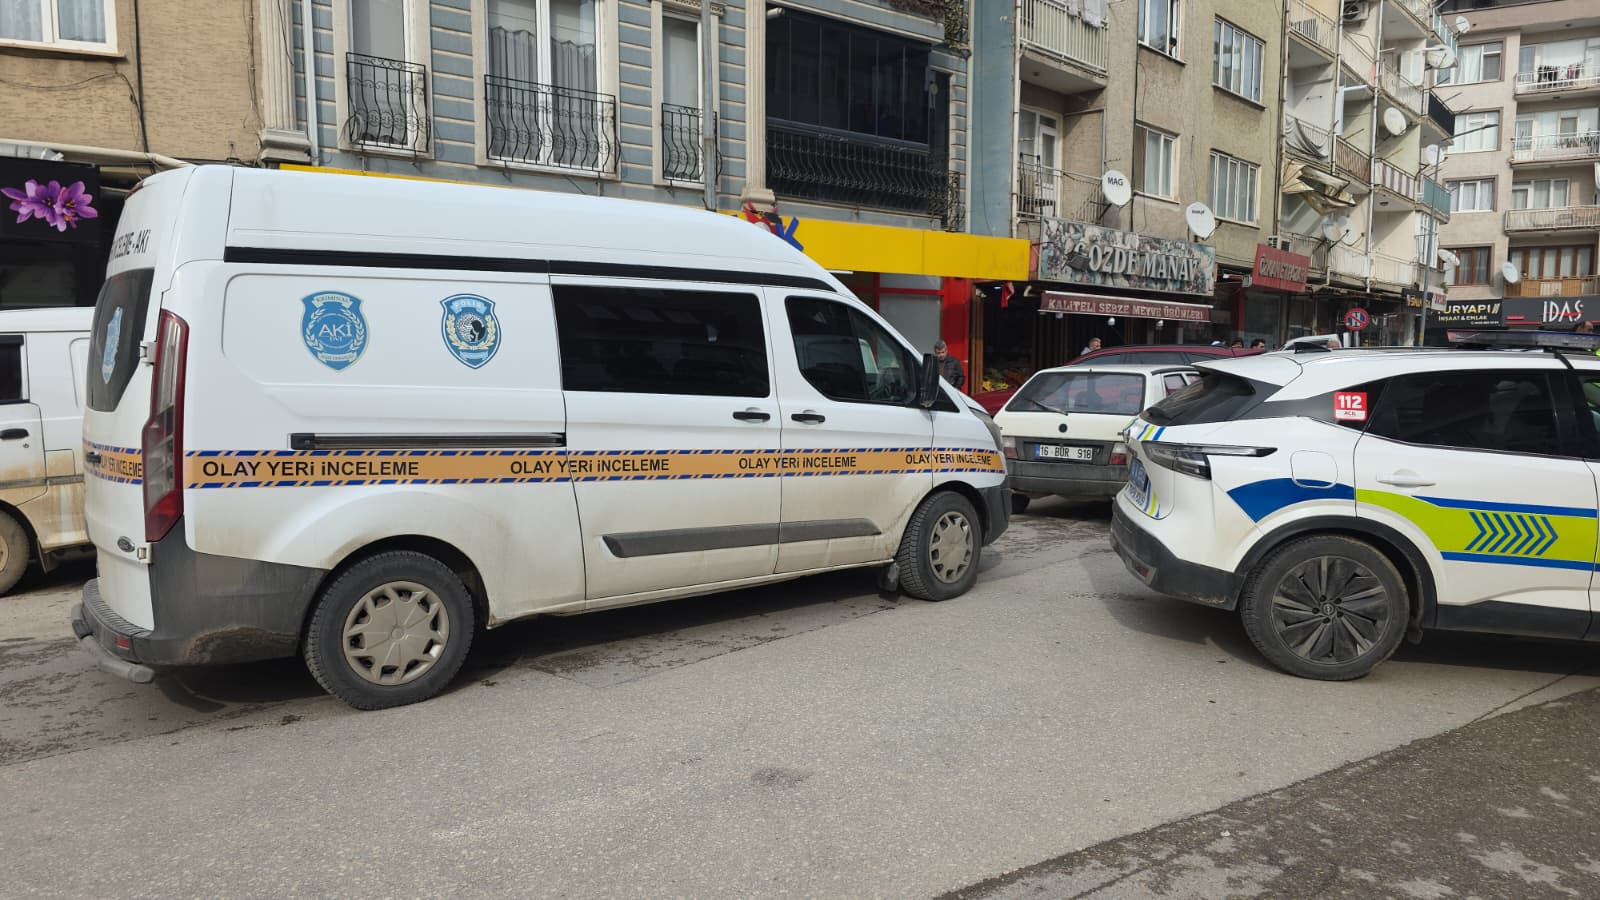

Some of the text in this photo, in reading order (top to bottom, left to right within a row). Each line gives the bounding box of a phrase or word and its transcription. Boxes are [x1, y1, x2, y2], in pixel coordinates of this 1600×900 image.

[1107, 176, 1124, 187] MAG
[1099, 302, 1129, 313] SEBZE
[1132, 304, 1161, 316] MEYVE
[1338, 395, 1362, 409] 112
[905, 453, 930, 464] OLAY
[1040, 446, 1049, 456] 16
[1077, 448, 1091, 460] 918
[202, 460, 261, 477] OLAY
[510, 460, 553, 474] OLAY
[738, 457, 770, 469] OLAY
